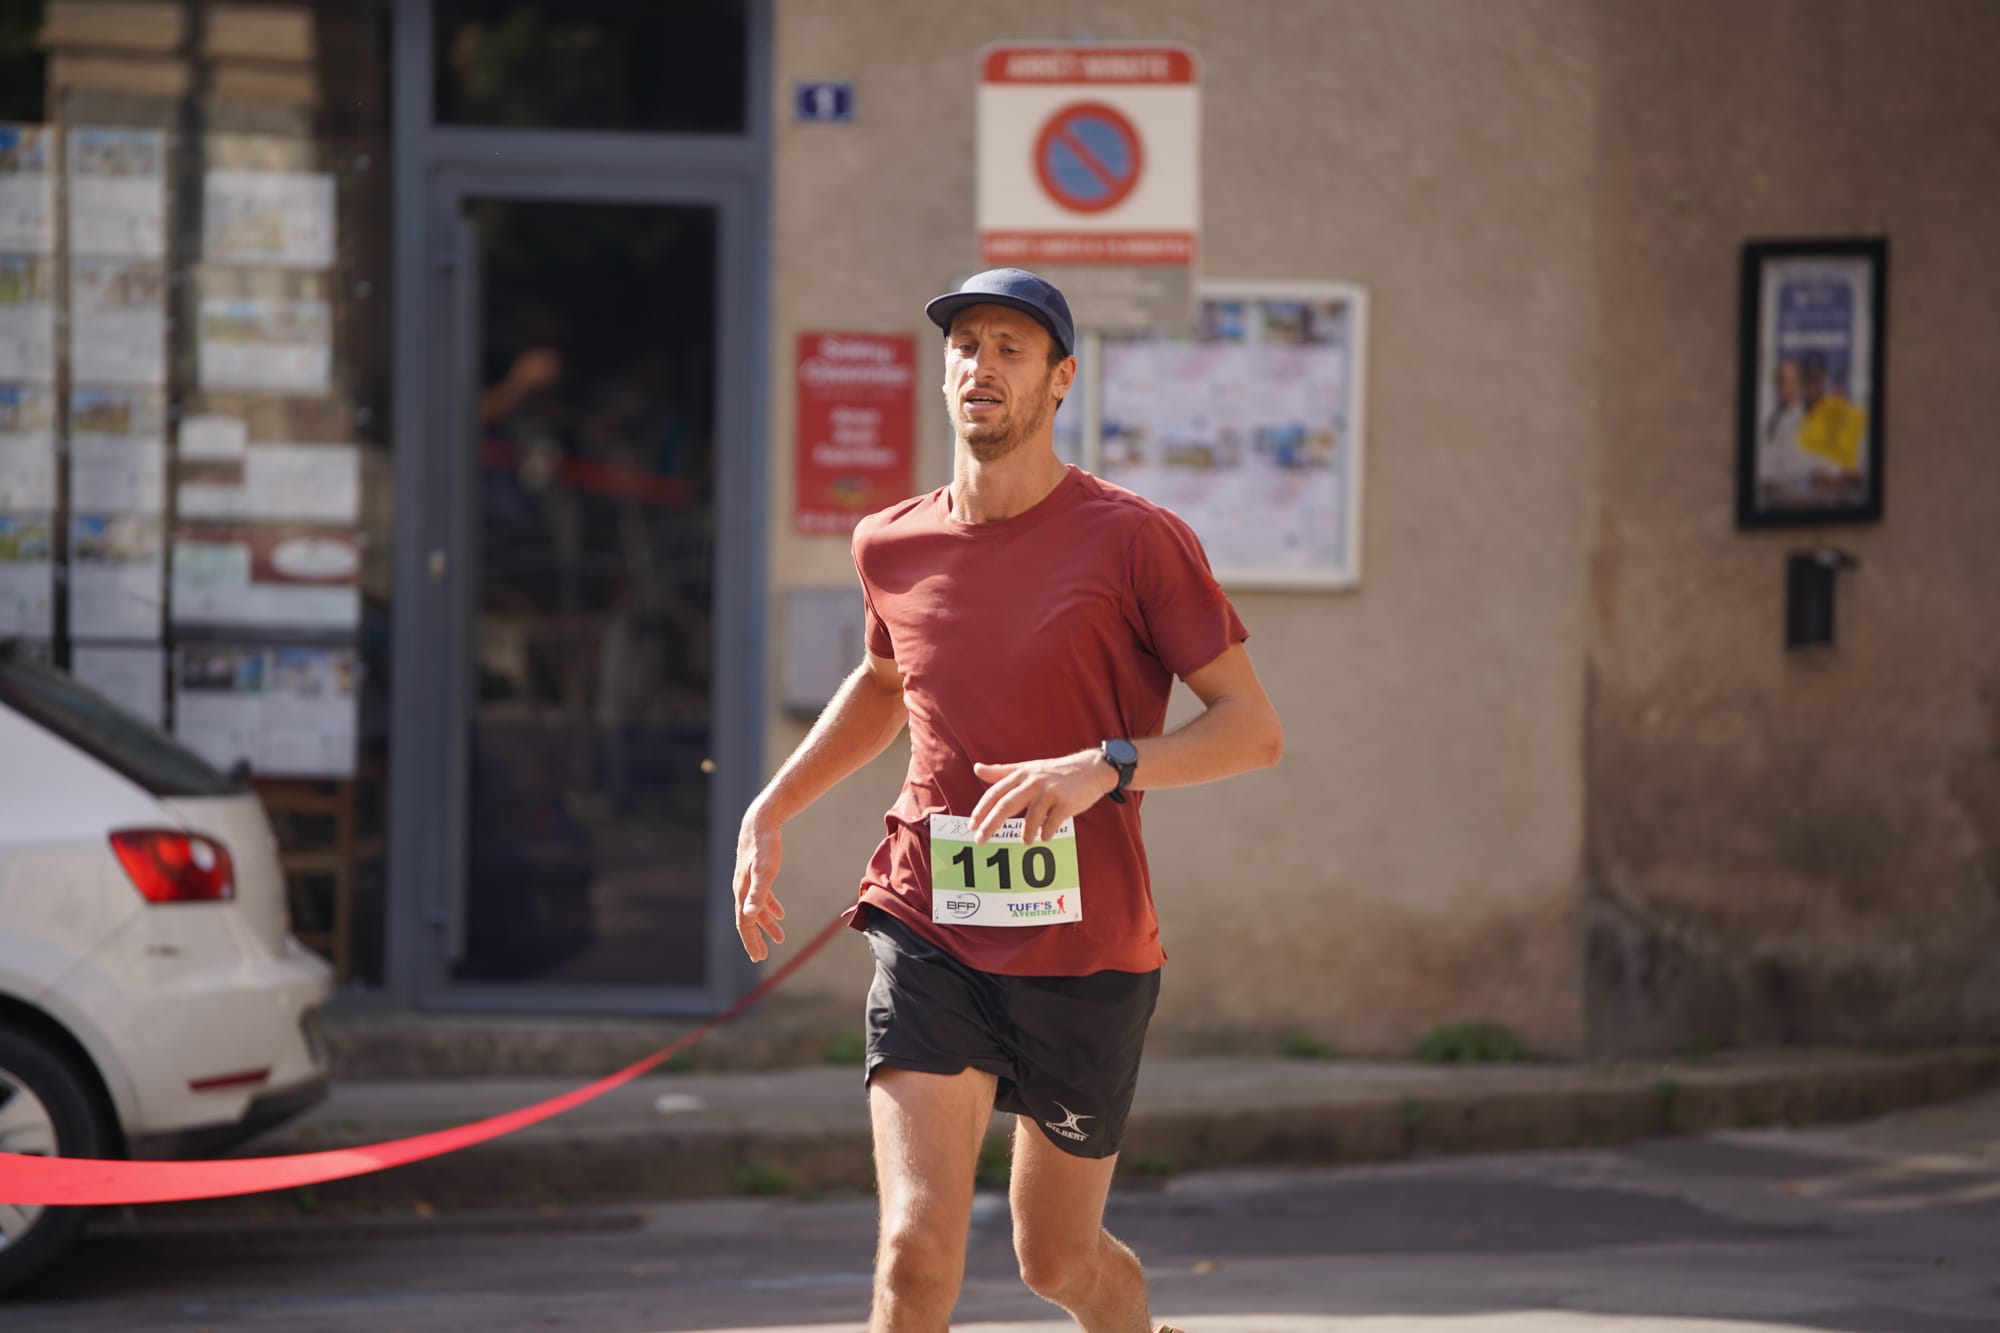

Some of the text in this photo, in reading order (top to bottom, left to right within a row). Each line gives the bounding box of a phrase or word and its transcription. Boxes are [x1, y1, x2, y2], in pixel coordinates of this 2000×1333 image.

[952, 846, 1056, 890] 110
[946, 901, 976, 910] BFP
[1007, 901, 1052, 912] TUFF'S
[1012, 908, 1057, 918] Aventure
[1045, 1121, 1087, 1142] GILBERT
